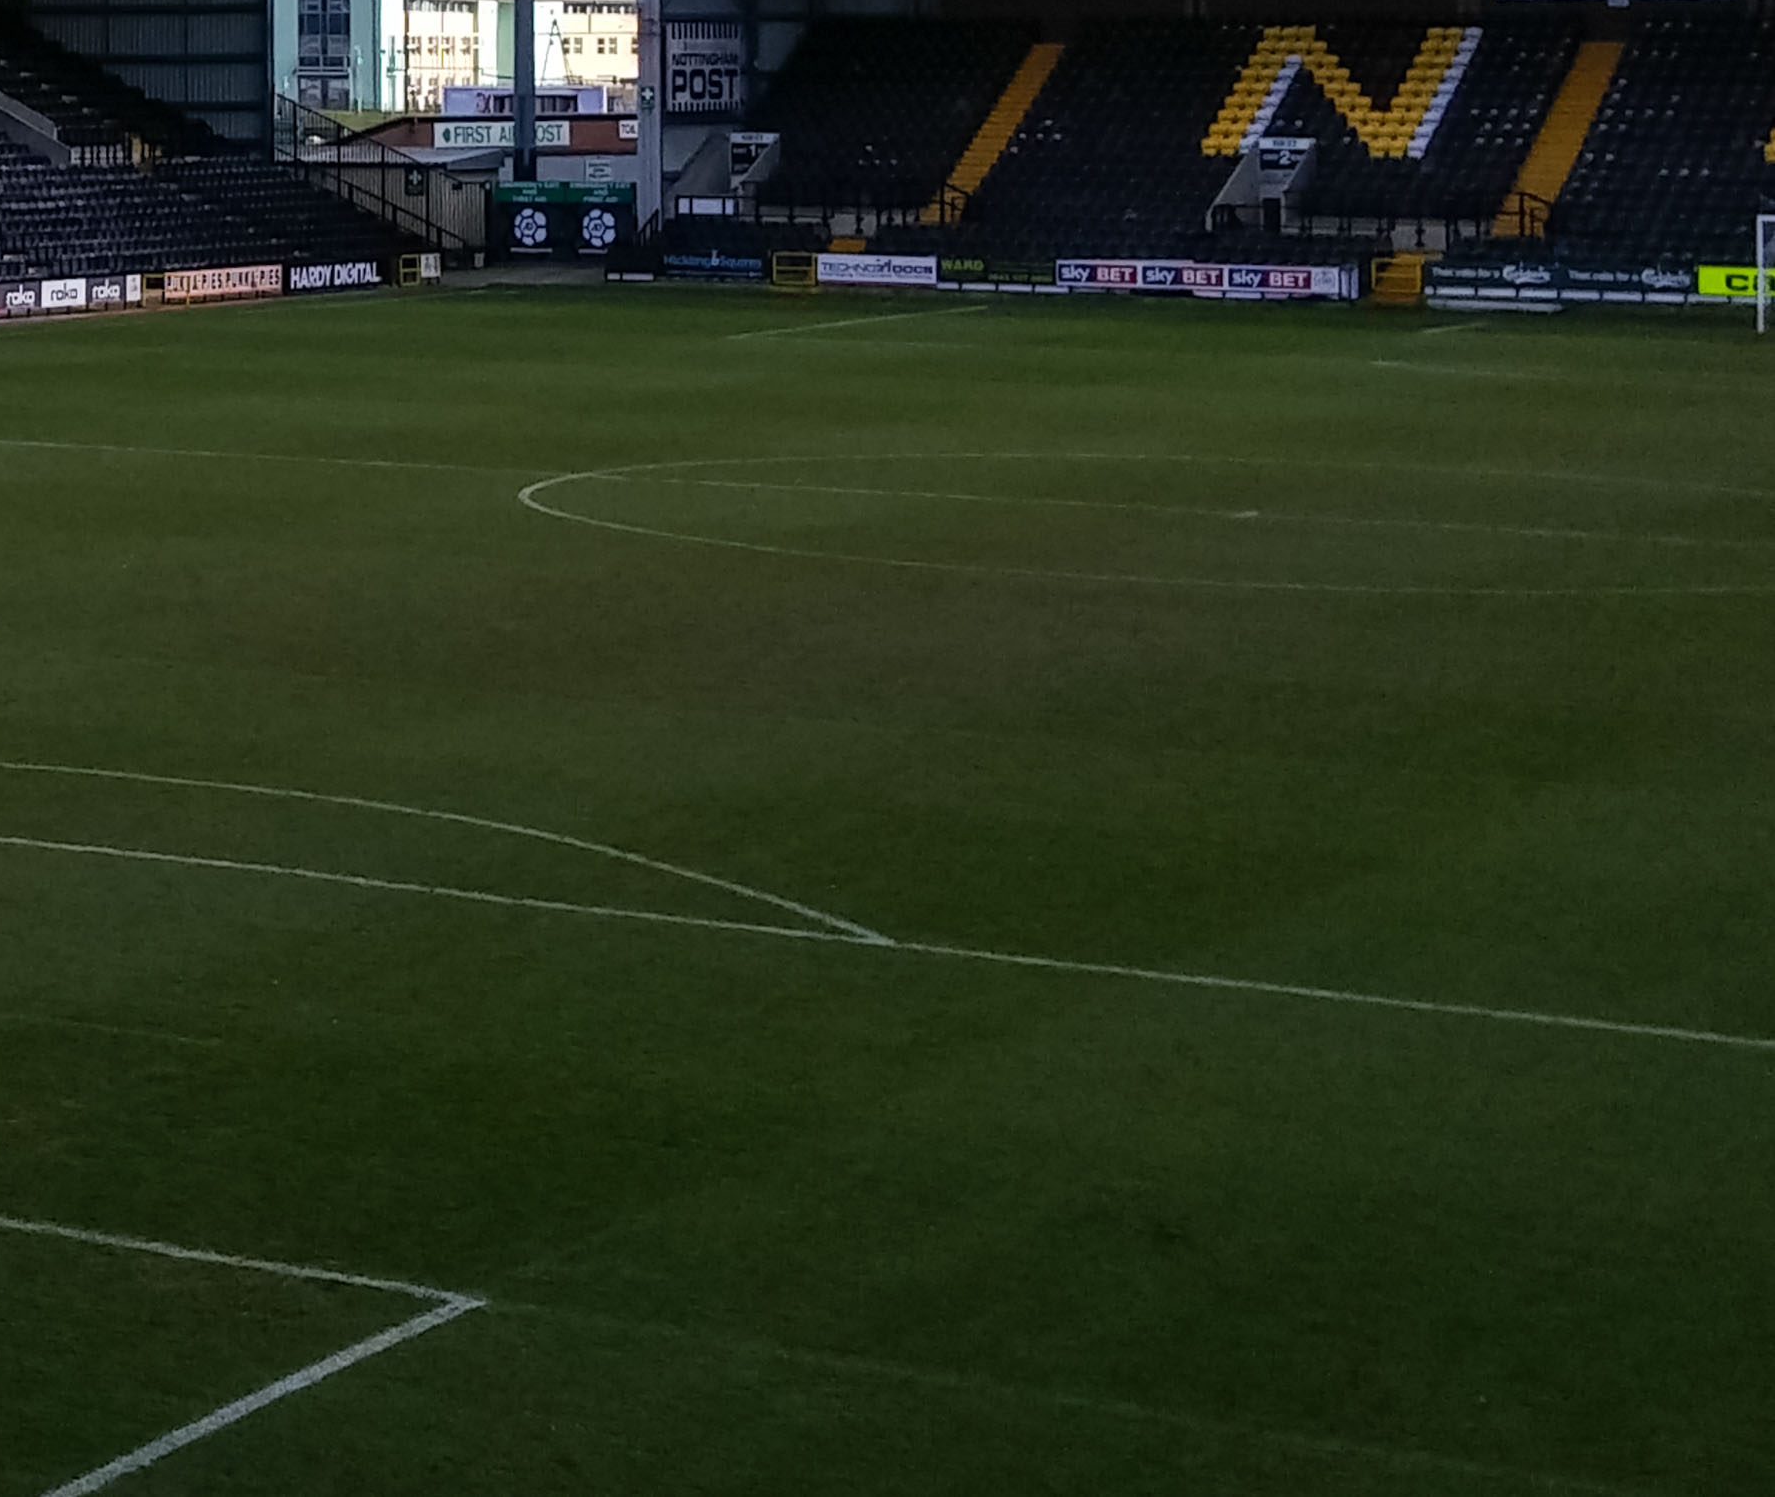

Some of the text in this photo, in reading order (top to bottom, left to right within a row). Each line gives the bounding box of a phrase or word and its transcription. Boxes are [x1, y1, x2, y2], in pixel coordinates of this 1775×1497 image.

[672, 69, 738, 100] POST
[454, 127, 491, 144] FIRST
[291, 262, 381, 290] HARDY DIGITAL
[1062, 265, 1089, 281] sky
[1097, 267, 1136, 282] BET
[1147, 267, 1220, 284] sky BET
[1232, 270, 1308, 287] sky BET
